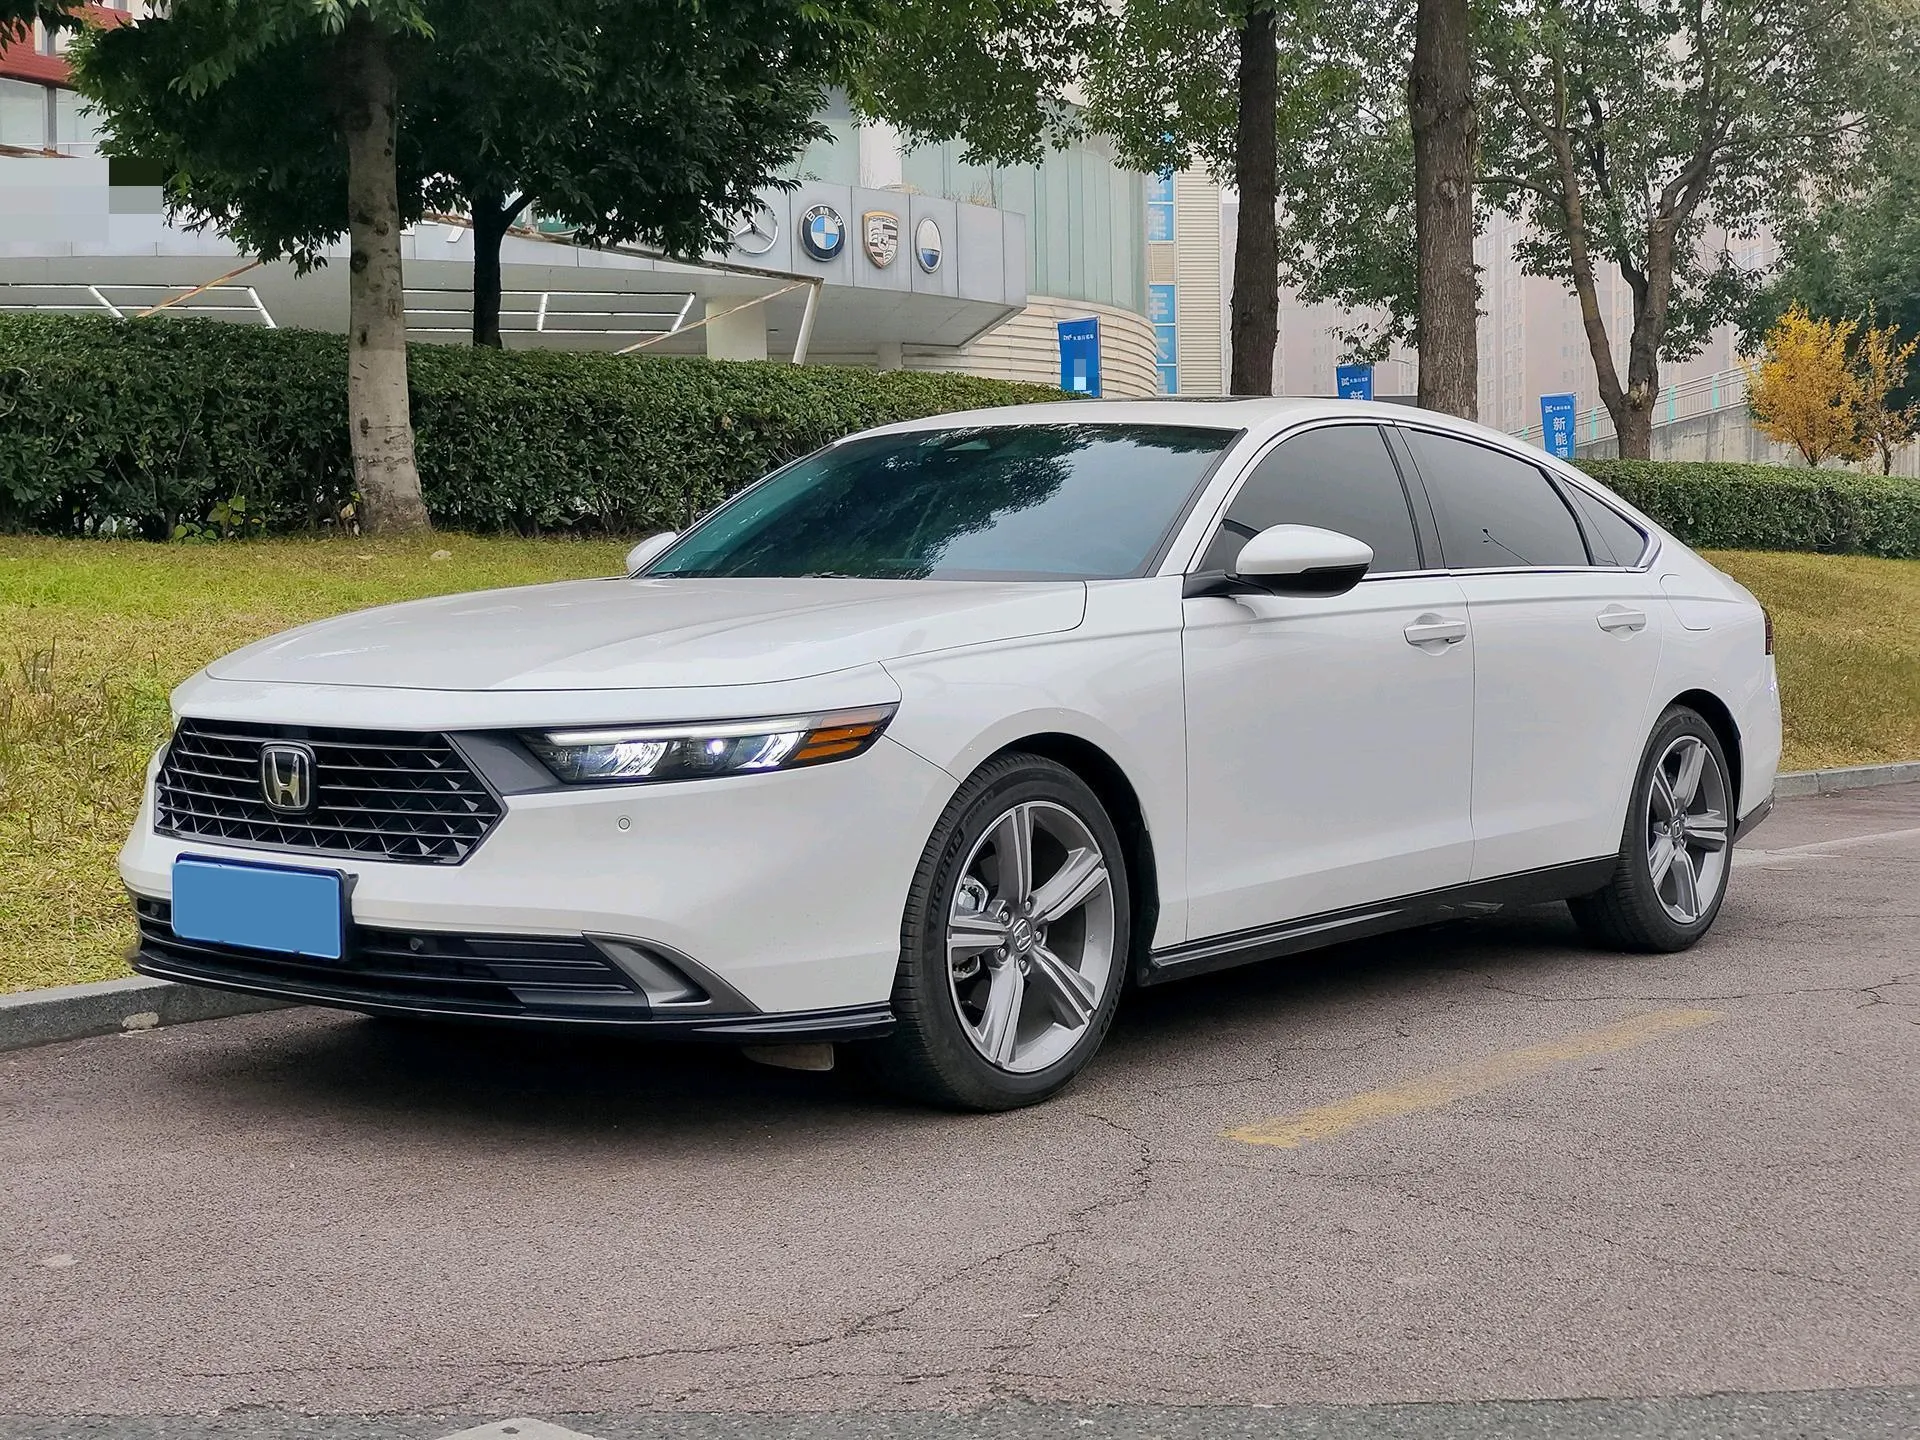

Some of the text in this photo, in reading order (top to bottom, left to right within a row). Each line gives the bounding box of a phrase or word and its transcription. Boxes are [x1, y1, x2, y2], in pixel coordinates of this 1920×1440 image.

[806, 207, 842, 226] BMW
[1553, 417, 1568, 458] 新能源
